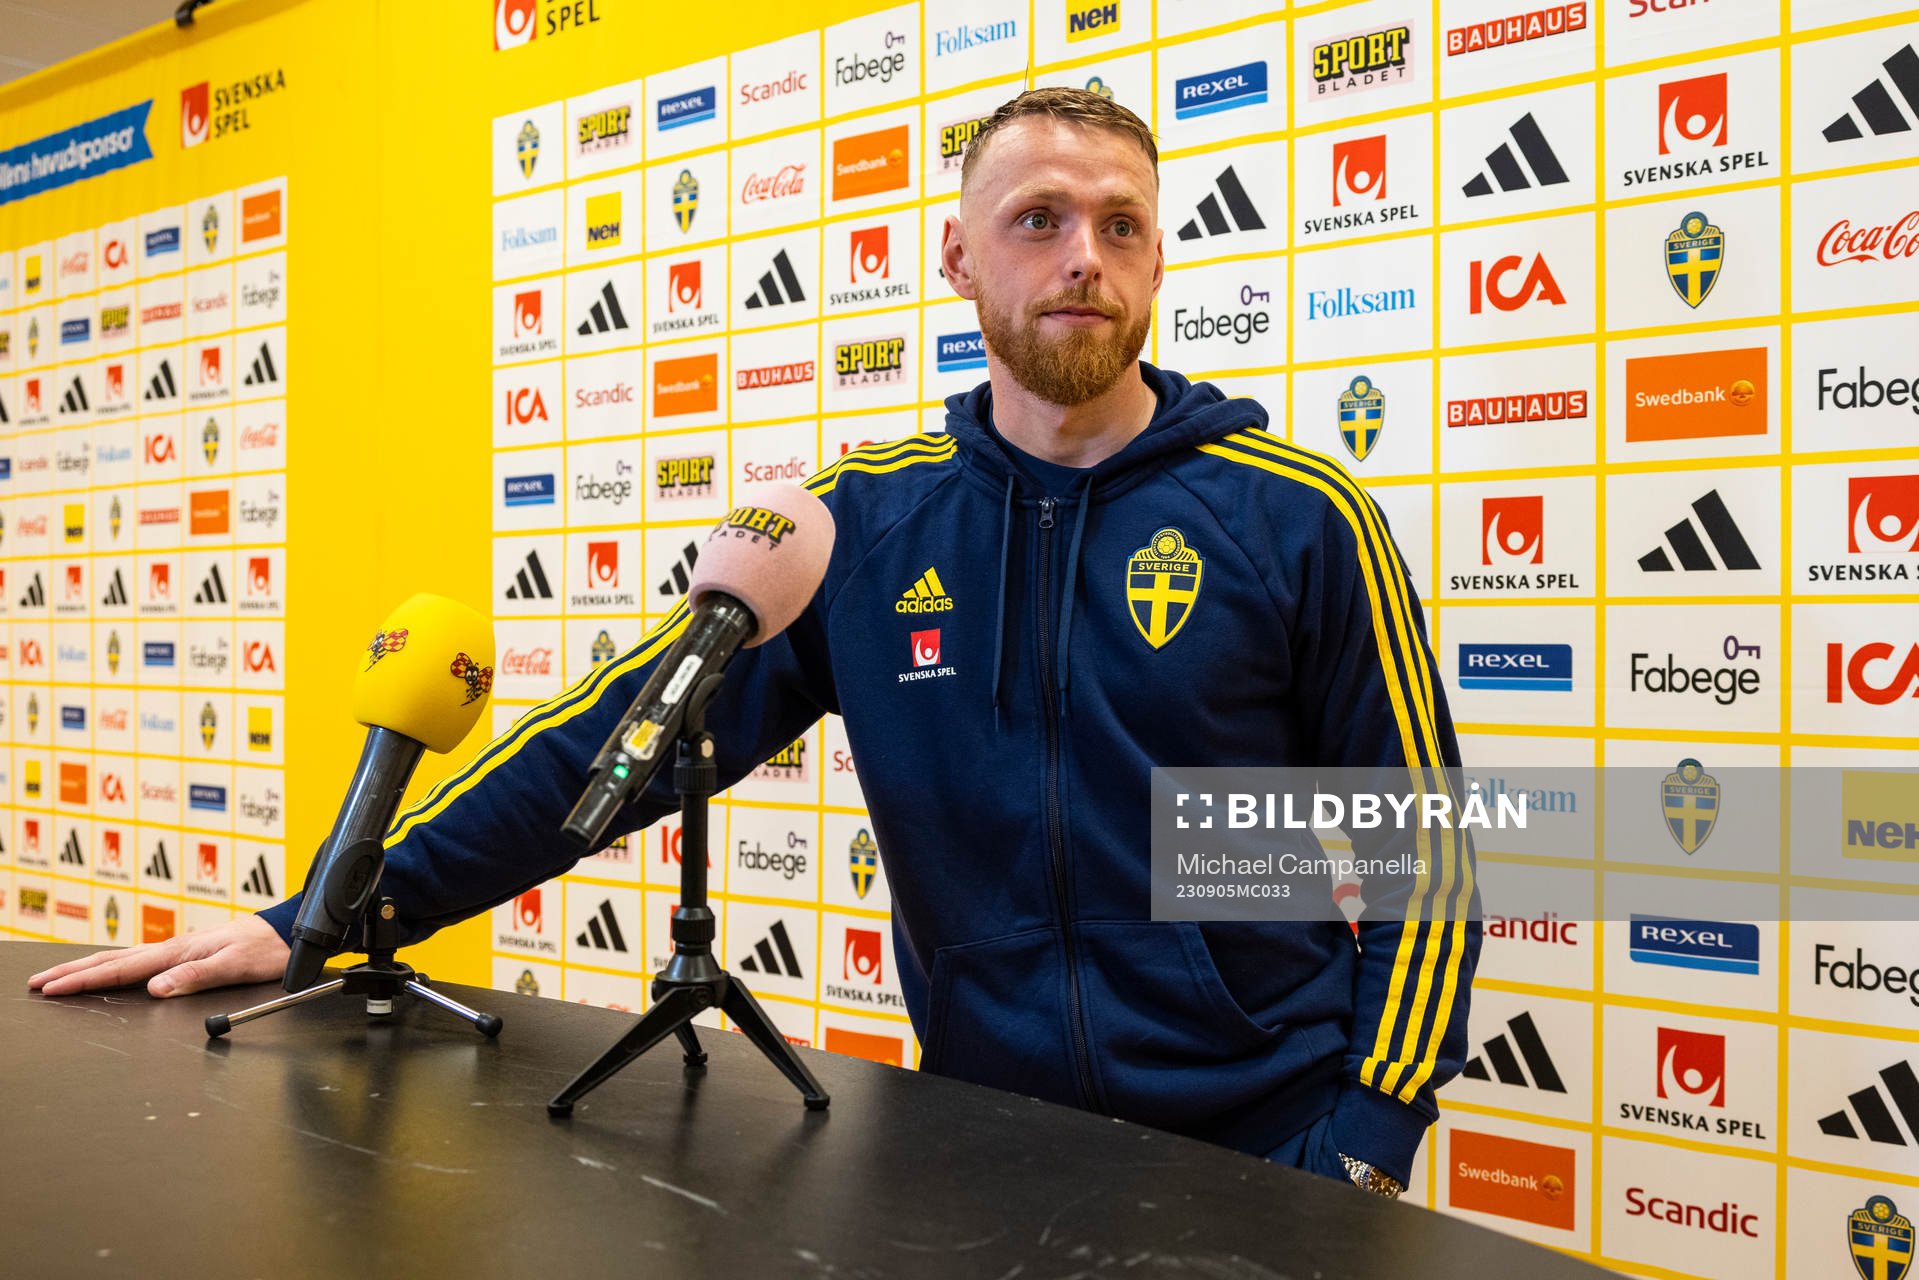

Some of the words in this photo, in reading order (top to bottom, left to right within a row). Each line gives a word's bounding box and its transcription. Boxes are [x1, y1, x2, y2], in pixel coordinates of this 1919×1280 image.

[547, 0, 600, 36] SPEL
[1447, 1, 1587, 57] BAUHAUS
[936, 18, 1017, 58] Folksam
[836, 52, 905, 87] Fabege
[1313, 27, 1411, 83] SPORT
[214, 68, 286, 111] SVENSKA
[740, 71, 808, 105] Scandic
[1317, 67, 1406, 95] BLADET
[214, 108, 251, 139] SPEL
[577, 104, 631, 145] SPORT
[941, 117, 991, 158] SPO
[836, 156, 888, 176] Swedbank
[1623, 159, 1713, 187] SVENSKA
[1719, 150, 1769, 173] SPEL
[742, 163, 807, 205] Coca-Cola
[1303, 214, 1375, 235] SVENSKA
[1380, 204, 1419, 223] SPEL
[502, 226, 557, 251] Folksam
[1673, 237, 1716, 250] SVERIGE
[1816, 211, 1919, 266] Coca-Co
[830, 291, 881, 306] SVENSKA
[884, 283, 911, 298] SPEL
[1470, 251, 1567, 314] ICA
[1307, 287, 1416, 321] Folksam
[653, 321, 695, 334] SVENSKA
[697, 314, 719, 326] SPEL
[1175, 306, 1270, 345] Fabege
[836, 337, 905, 376] SPORT
[736, 361, 815, 390] BAUHAUS
[839, 371, 903, 386] BLADET
[1818, 366, 1919, 416] Fabe
[506, 386, 548, 426] ICA
[576, 384, 633, 409] Scandic
[1447, 390, 1588, 428] BAUHAUS
[1635, 386, 1726, 407] Swedbank
[656, 456, 714, 488] SPORT
[744, 457, 807, 483] Scandic
[576, 475, 631, 505] Fabege
[709, 530, 777, 551] ADET
[712, 506, 796, 544] ORT
[1138, 562, 1190, 573] SVERIGE
[1450, 574, 1531, 590] SVENSKA
[1536, 573, 1579, 589] SPEL
[1808, 563, 1909, 581] SVENSKA
[572, 595, 612, 607] SVENSKA
[613, 594, 635, 606] SPEL
[895, 595, 954, 614] adidas
[242, 640, 275, 673] ICA
[502, 648, 554, 676] Coca-Cola
[898, 669, 936, 683] SVENSKA
[937, 667, 957, 677] SPEL
[1631, 653, 1761, 706] Fabege
[1669, 785, 1711, 796] SVERIGE
[738, 840, 806, 880] Fabege
[1482, 910, 1578, 946] andic
[1815, 944, 1919, 1007] Fabe
[826, 984, 873, 1003] SVENSKA
[1620, 1103, 1710, 1132] SVENSKA
[1716, 1118, 1767, 1140] SPEL
[1458, 1162, 1538, 1191] Swedbank
[1625, 1187, 1759, 1238] Scandic
[1857, 1222, 1905, 1237] SVERIGE
